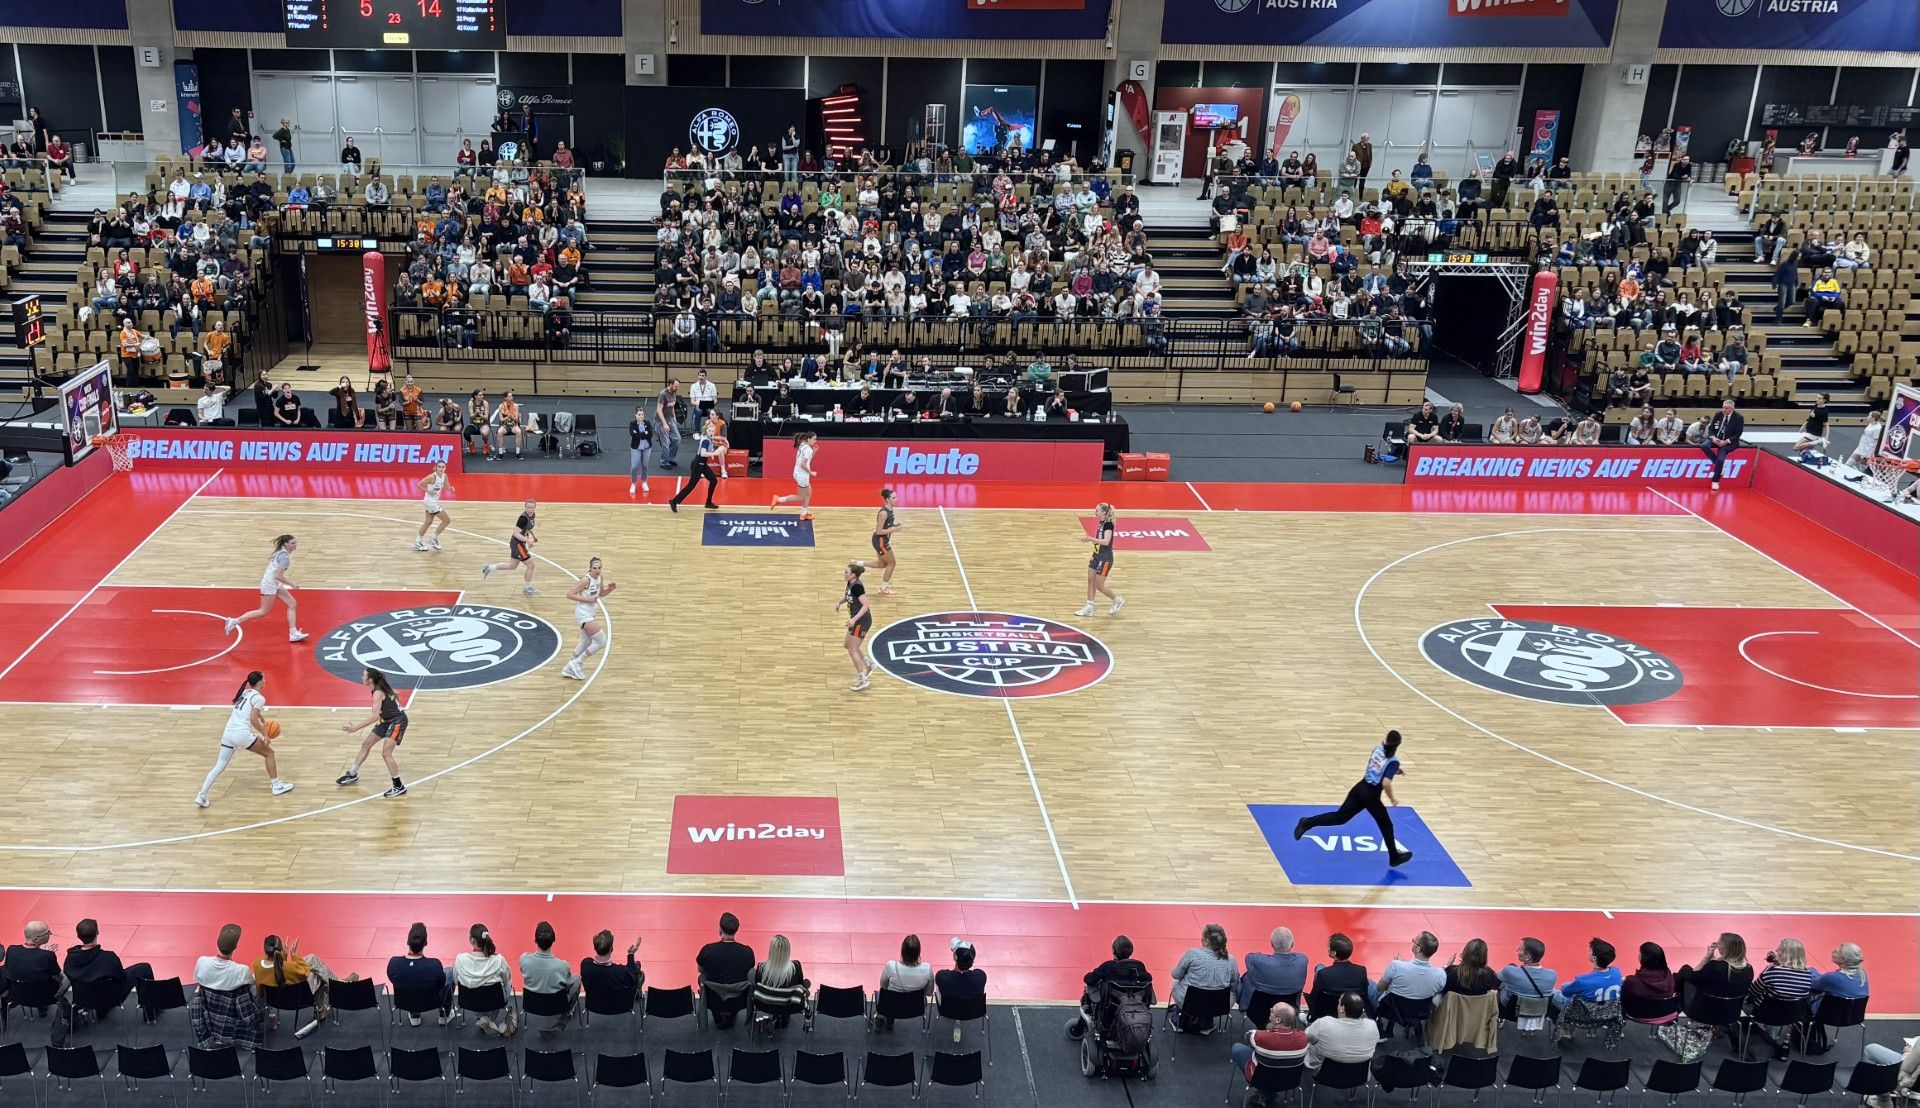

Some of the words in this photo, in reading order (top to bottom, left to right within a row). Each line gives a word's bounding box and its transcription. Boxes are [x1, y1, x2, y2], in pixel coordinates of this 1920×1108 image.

[360, 0, 373, 17] 5
[417, 0, 442, 18] 14
[1767, 0, 1839, 13] AUSTRIA
[388, 13, 402, 24] 23
[144, 50, 152, 63] E
[640, 58, 648, 70] F
[1135, 64, 1145, 77] G
[1632, 68, 1644, 80] H
[518, 95, 540, 105] Alfa
[541, 94, 573, 104] Romeo
[692, 113, 708, 135] ALFA
[711, 110, 737, 136] ROMEO
[1448, 254, 1472, 263] 15:38
[1528, 287, 1551, 356] win2day
[128, 439, 234, 461] BREAKING
[239, 441, 302, 462] NEWS
[306, 442, 349, 462] AUF
[354, 443, 453, 464] HEUTE.AT
[884, 446, 980, 475] Heute
[1414, 456, 1525, 477] BREAKING
[1527, 458, 1593, 478] NEWS
[1593, 458, 1641, 478] AUF
[1113, 529, 1190, 539] win2d
[322, 622, 377, 662] ALFA
[389, 607, 538, 631] ROMEO
[929, 631, 1041, 640] BASKETBALL
[902, 641, 1079, 657] AUSTRIA
[1437, 620, 1527, 644] ALFA
[1551, 624, 1675, 681] ROMEO
[963, 657, 1022, 667] CUP
[235, 696, 248, 710] 21
[687, 823, 825, 843] win2day
[1594, 984, 1621, 1002] 10
